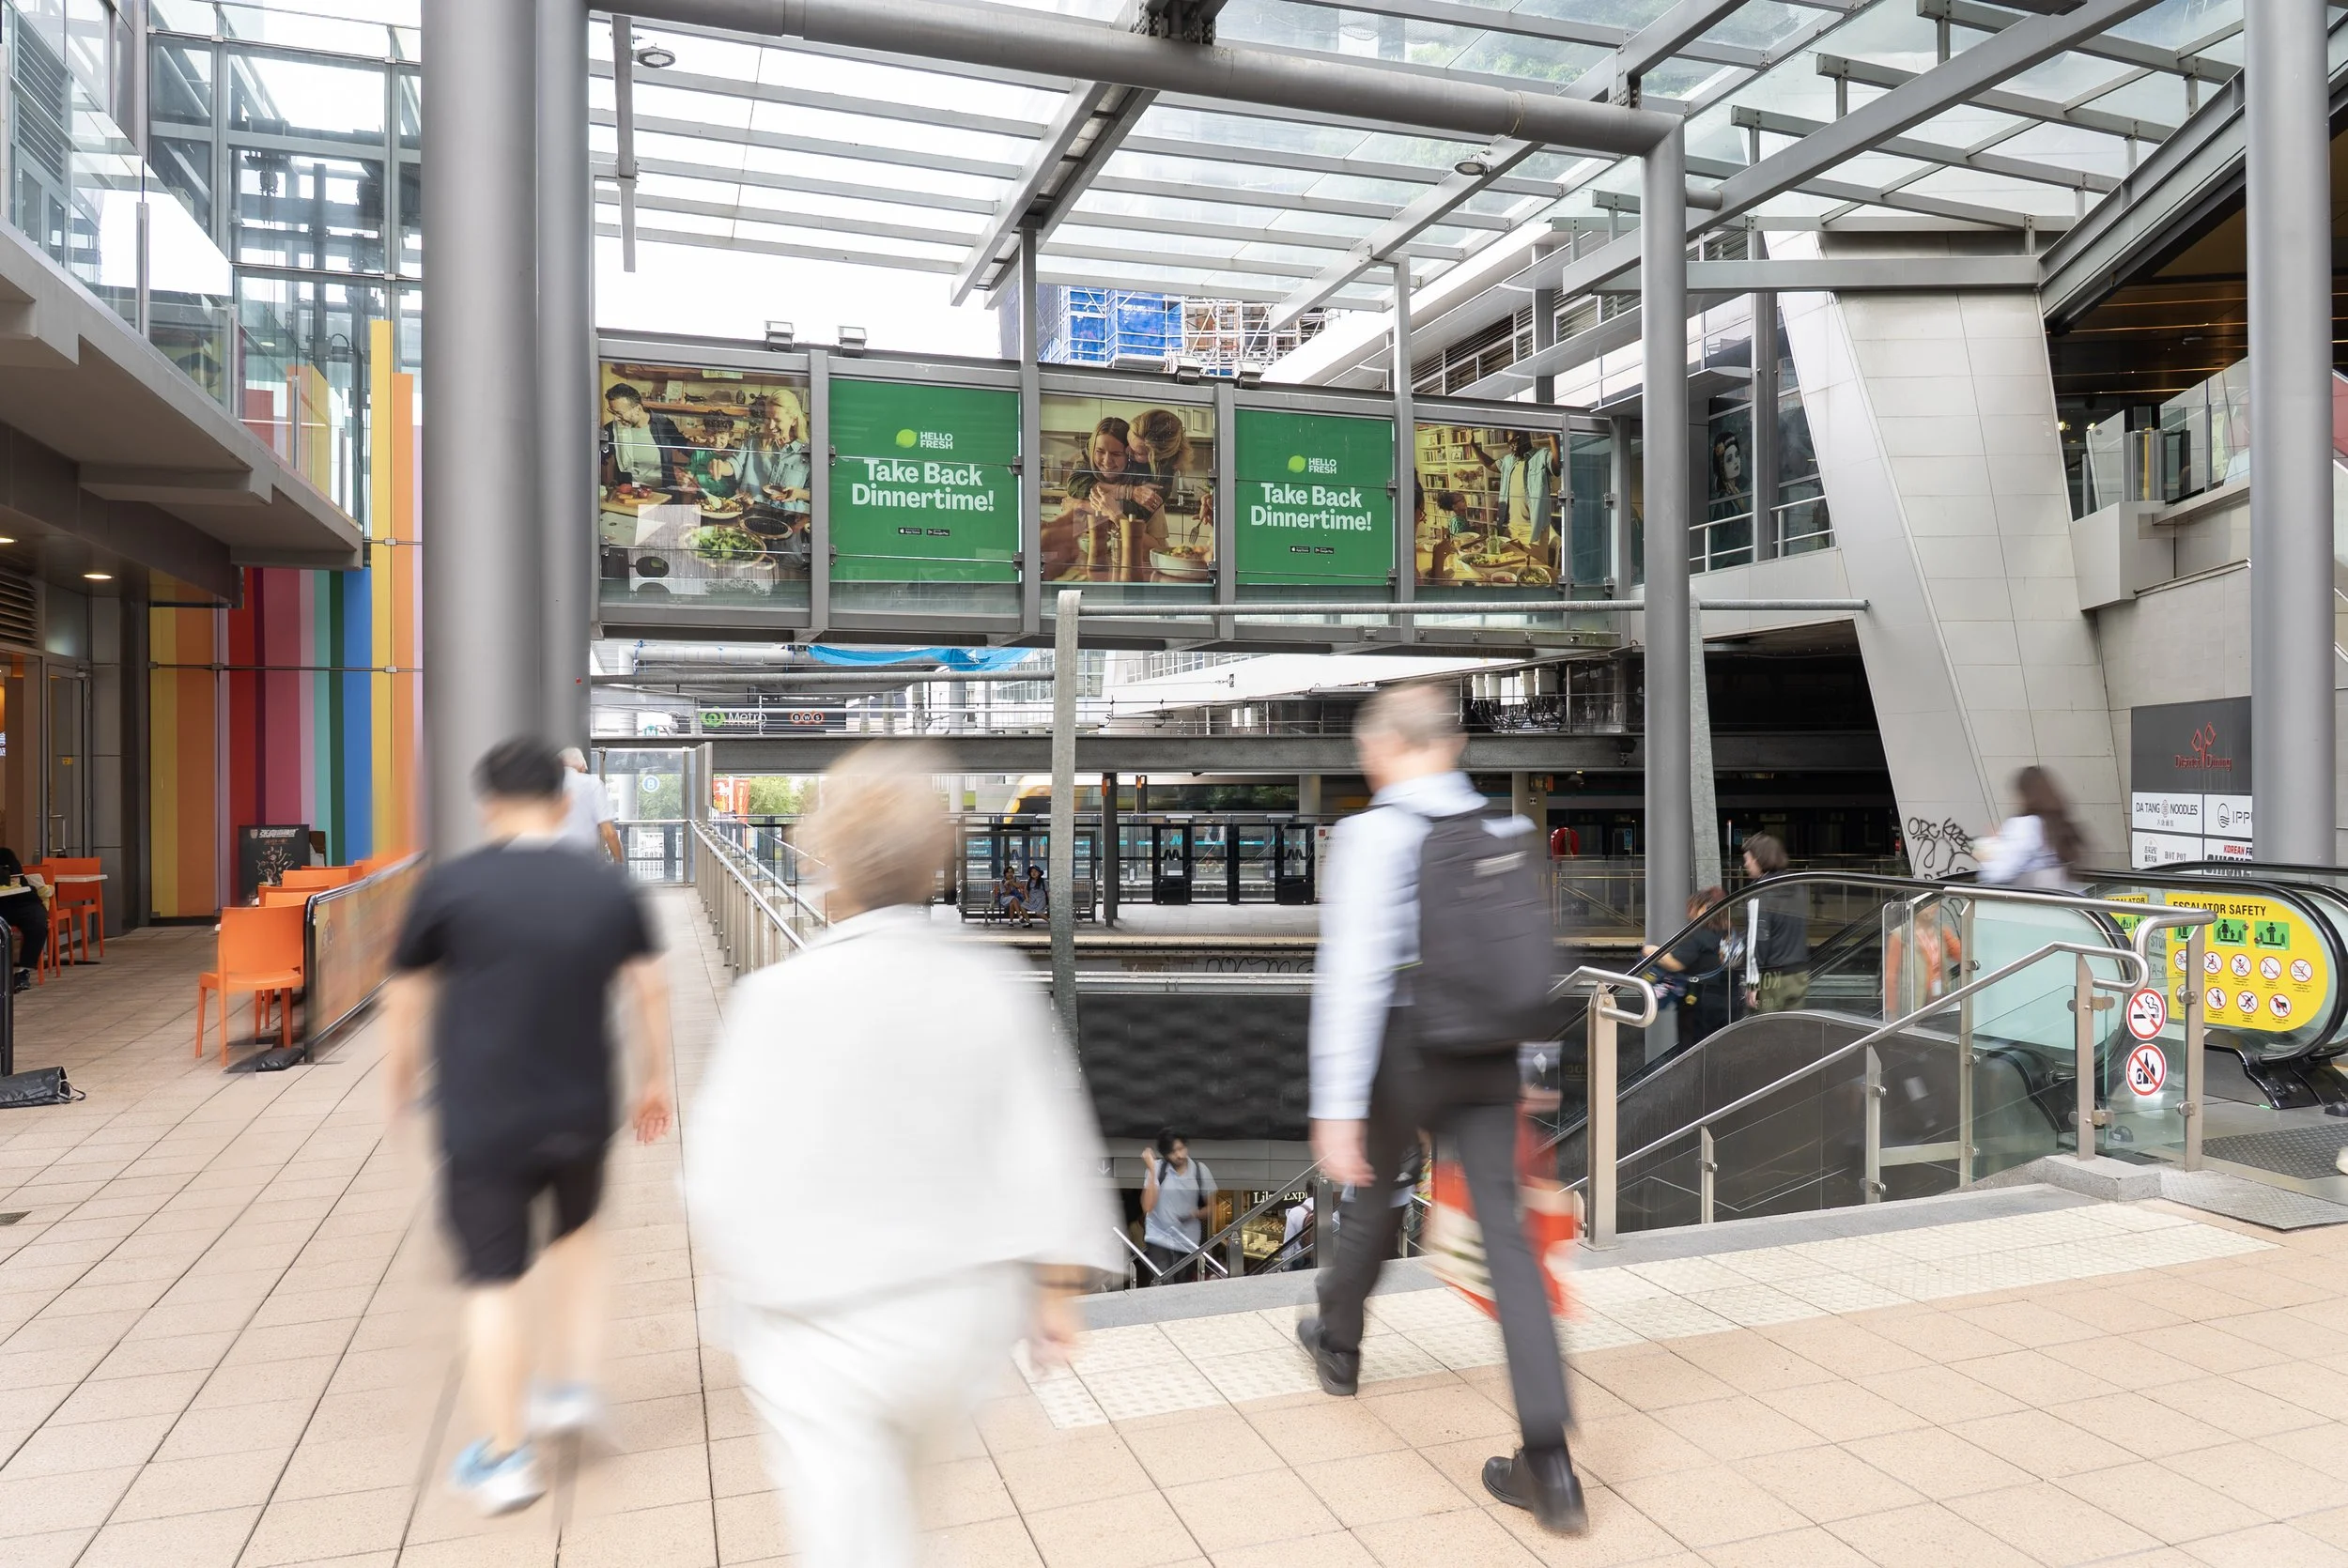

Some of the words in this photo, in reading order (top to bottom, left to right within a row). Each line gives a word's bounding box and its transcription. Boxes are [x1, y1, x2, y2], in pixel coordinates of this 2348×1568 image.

[919, 431, 953, 441] HELLO
[919, 439, 953, 450] FRESH
[1308, 457, 1336, 467] HELLO
[864, 458, 919, 483] Take
[924, 461, 982, 486] Back
[1308, 465, 1336, 474] FRESH
[852, 483, 995, 512] Dinnertime!
[1260, 483, 1307, 505] Take
[1312, 484, 1362, 508] Back
[1251, 505, 1372, 531] Dinnertime!
[728, 712, 767, 722] Metro
[2207, 754, 2232, 771] Dining
[2136, 802, 2143, 812] DA
[2145, 803, 2160, 814] TANG
[2170, 804, 2199, 815] NOODLES
[2223, 844, 2245, 855] KOREAN
[2229, 903, 2266, 916] SAFETY
